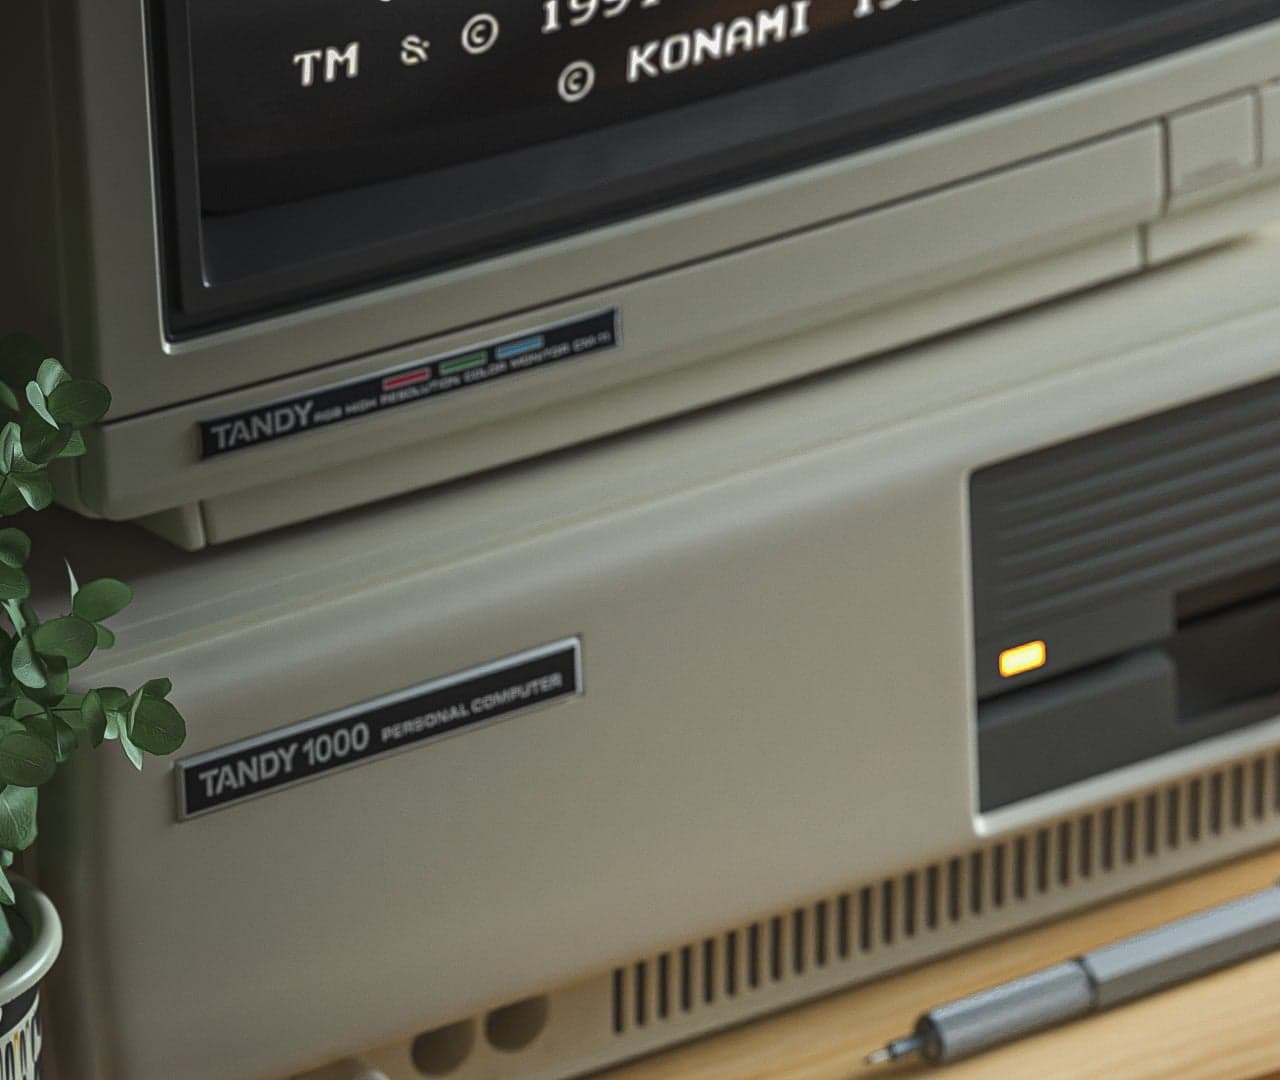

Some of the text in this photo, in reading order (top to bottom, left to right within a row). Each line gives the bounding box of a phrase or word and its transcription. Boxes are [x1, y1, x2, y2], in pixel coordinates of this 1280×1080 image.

[293, 42, 360, 87] TM
[625, 2, 812, 84] KONAMI
[210, 399, 315, 451] TANDY
[199, 671, 563, 799] TANDY 1000 PERSONAL COMPUTER
